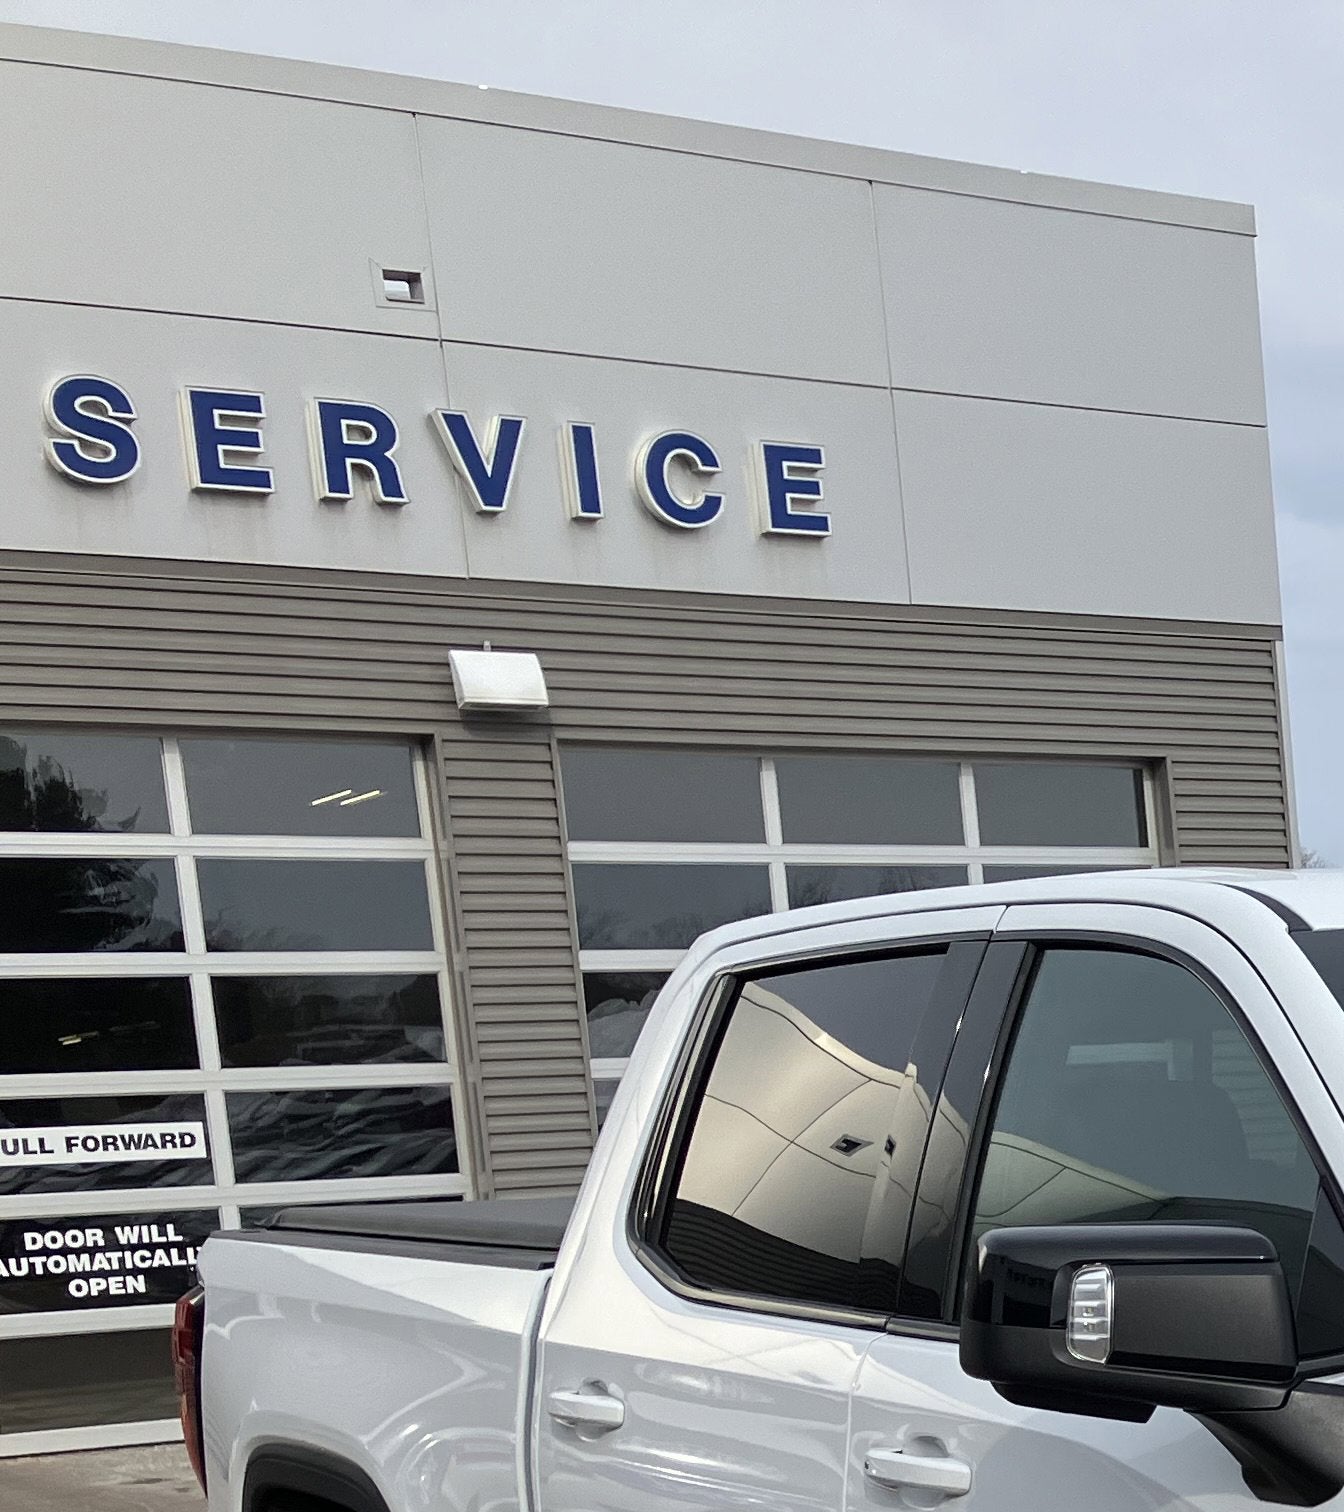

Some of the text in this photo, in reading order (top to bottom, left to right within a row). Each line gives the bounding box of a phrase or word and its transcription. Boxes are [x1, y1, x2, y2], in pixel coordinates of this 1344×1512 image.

[46, 374, 832, 538] SERVICE
[65, 1131, 197, 1153] FORWARD
[24, 1223, 183, 1251] DOOR WILL
[0, 1246, 201, 1277] UTOMATICALL
[68, 1274, 146, 1297] OPEN
